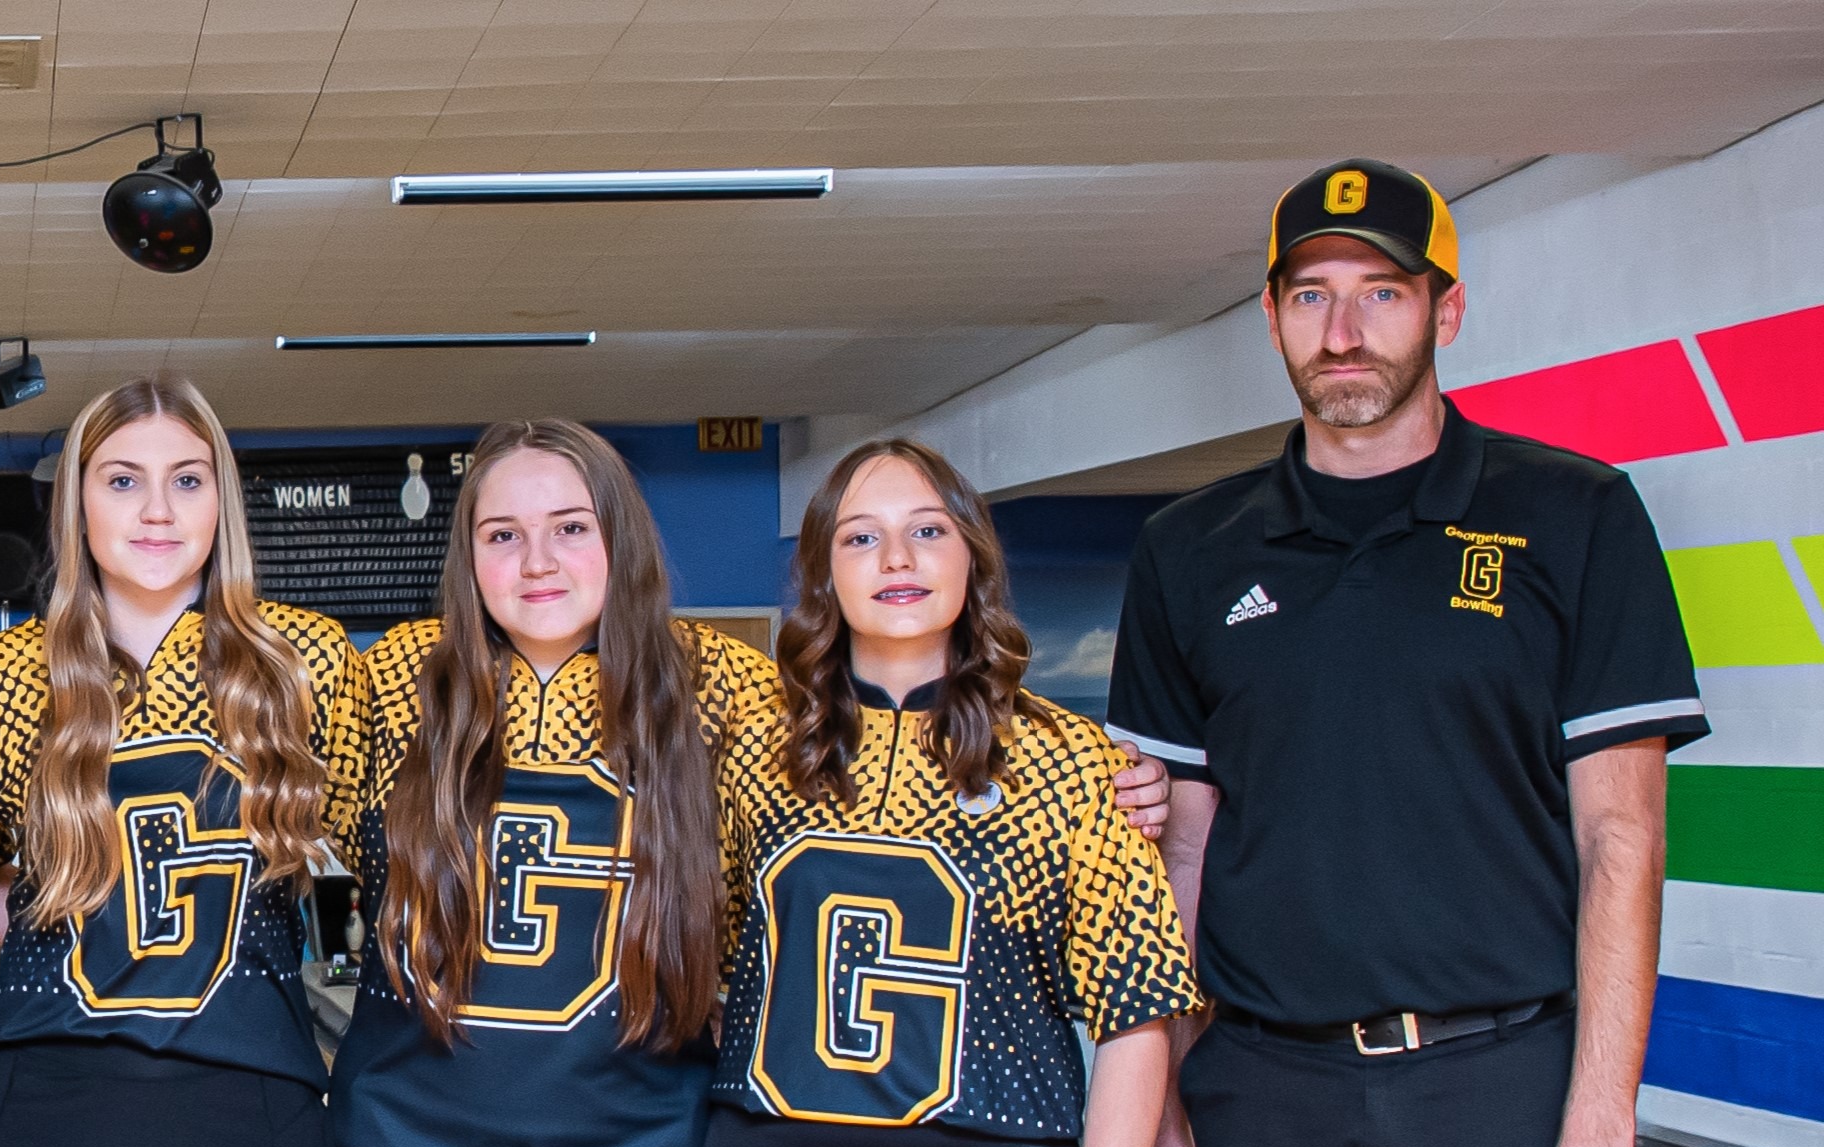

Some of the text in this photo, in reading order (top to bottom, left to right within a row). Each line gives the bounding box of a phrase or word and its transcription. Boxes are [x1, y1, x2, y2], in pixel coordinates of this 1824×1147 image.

[1324, 170, 1368, 215] G
[706, 419, 758, 448] EXIT
[274, 484, 351, 508] WOMEN
[1445, 526, 1527, 547] Georgetown
[1460, 546, 1503, 599] G
[1226, 601, 1277, 625] adidas
[1450, 597, 1504, 617] Bowling
[64, 734, 254, 1018] G
[402, 757, 636, 1032] G
[747, 830, 975, 1127] G
